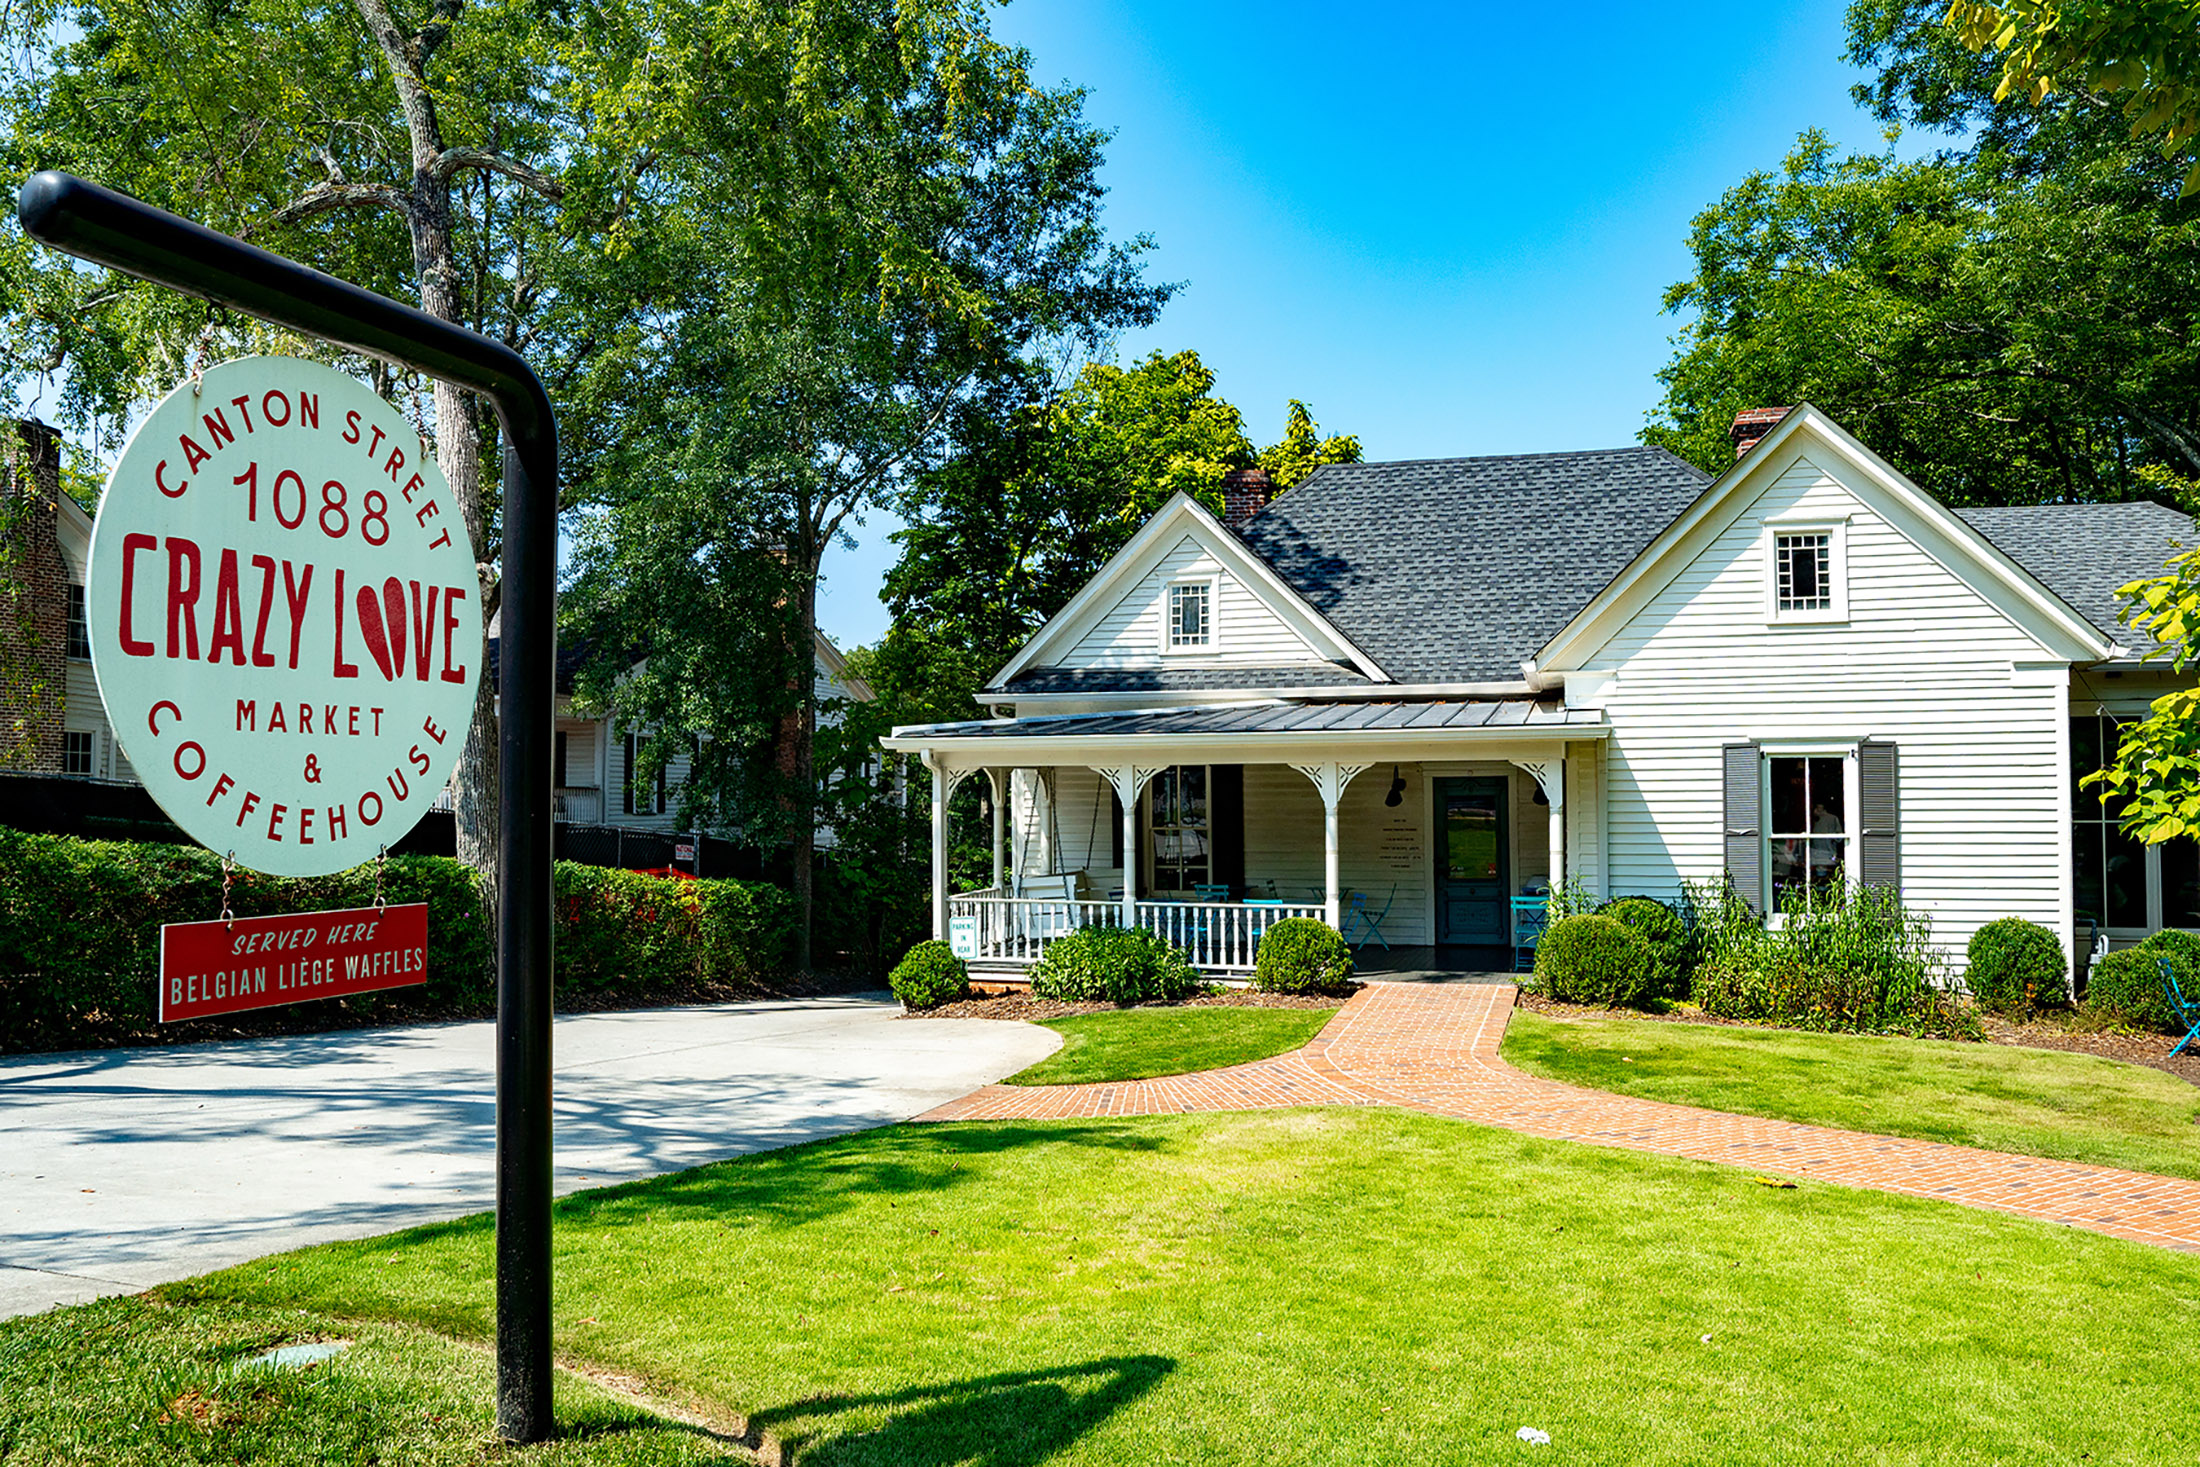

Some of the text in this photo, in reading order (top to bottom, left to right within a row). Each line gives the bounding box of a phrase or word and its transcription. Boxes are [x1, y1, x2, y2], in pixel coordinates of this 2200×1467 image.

[155, 390, 451, 550] CANTON STREET
[233, 462, 390, 546] 1088
[119, 533, 465, 684] CRAZY LOVE
[237, 700, 383, 736] MARKET
[149, 700, 446, 844] COFFEEHOUSE
[304, 754, 321, 783] &
[231, 922, 378, 955] SERVED HERE
[957, 945, 970, 953] REAR
[171, 948, 422, 1005] BELGIAN LIÈGE WAFFLES
